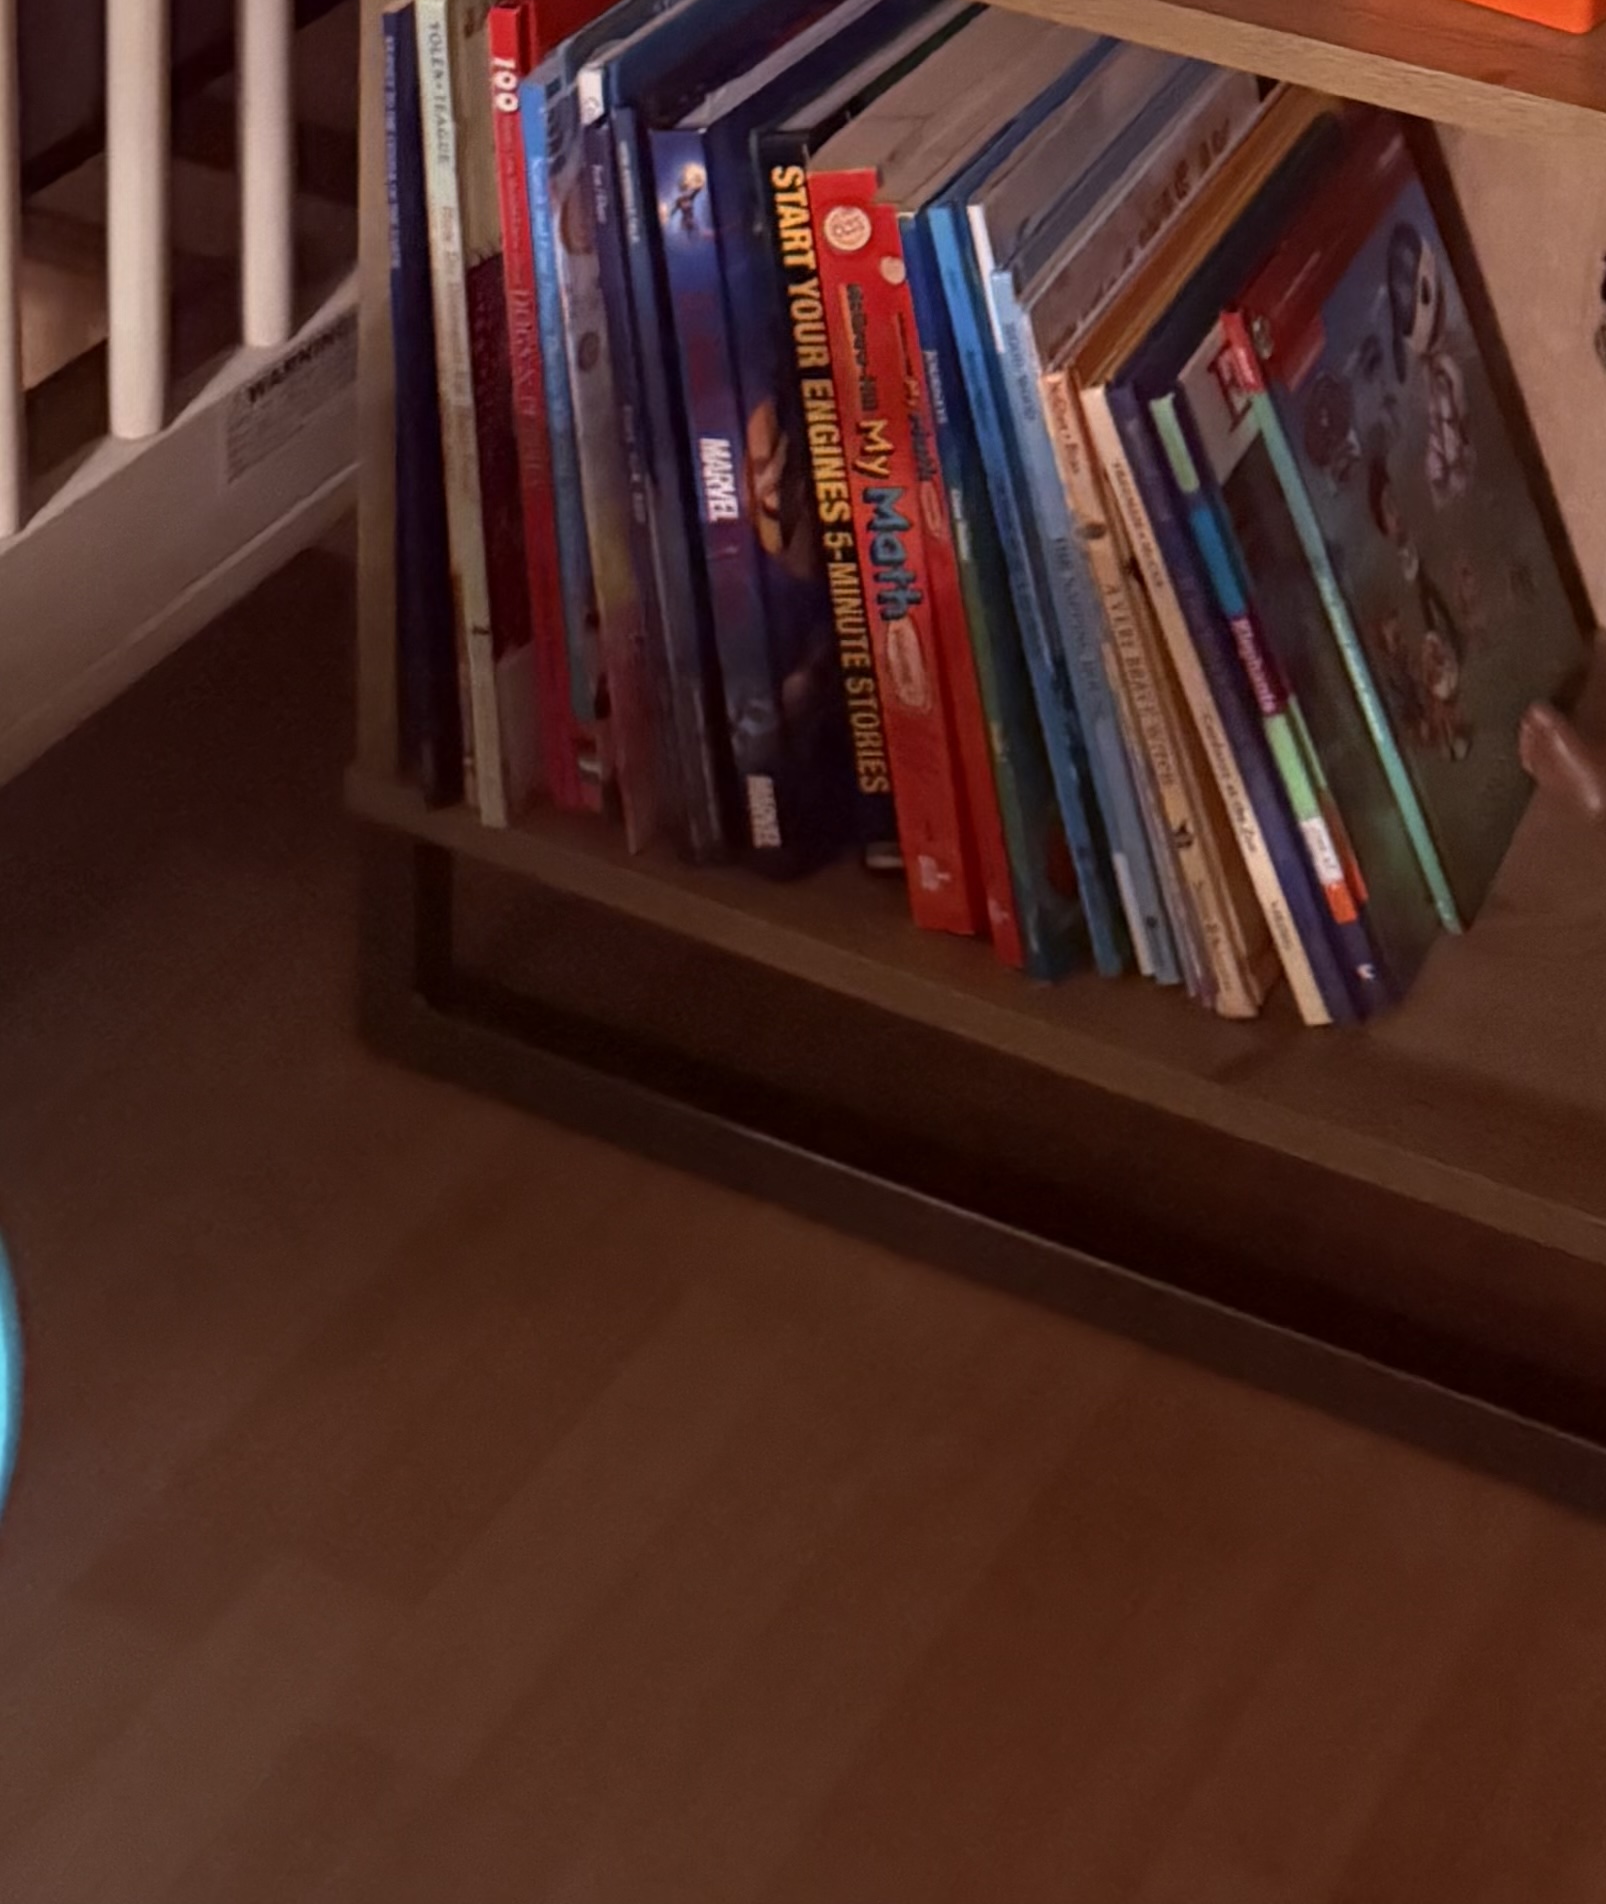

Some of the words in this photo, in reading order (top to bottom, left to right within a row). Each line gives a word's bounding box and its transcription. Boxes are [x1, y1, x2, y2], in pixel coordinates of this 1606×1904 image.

[427, 21, 447, 81] YOLEN
[492, 56, 519, 113] 100
[432, 91, 454, 166] TEAGUE
[771, 164, 816, 273] START
[787, 276, 829, 369] YOUR
[700, 437, 739, 522] MARVEL
[801, 378, 851, 523] ENGINES
[852, 418, 895, 479] My
[861, 485, 923, 622] Math
[823, 531, 870, 670] 5-MINUTE
[1233, 617, 1278, 715] Elephants
[845, 677, 889, 794] STORIES
[746, 773, 782, 849] MARVEL
